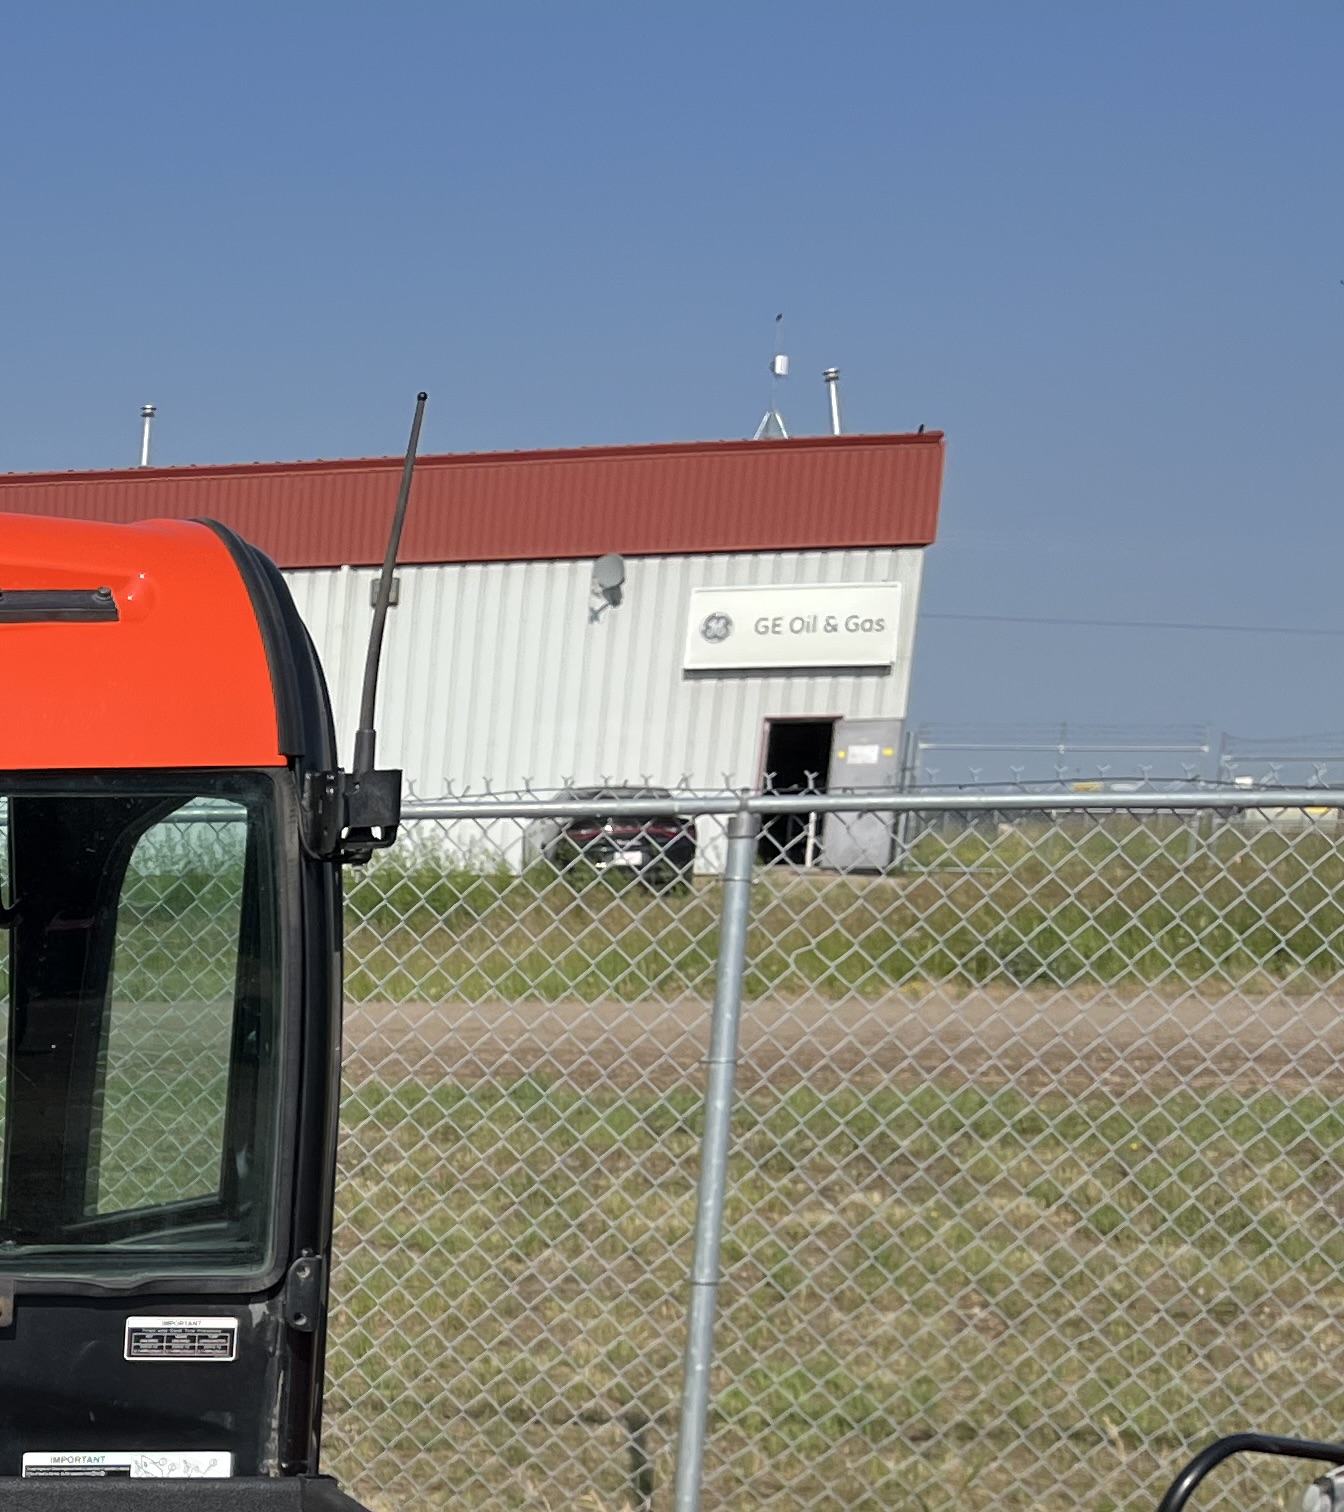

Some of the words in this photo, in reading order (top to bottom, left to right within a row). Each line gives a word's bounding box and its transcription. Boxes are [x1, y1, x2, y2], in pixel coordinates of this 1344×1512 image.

[754, 616, 783, 635] GE
[789, 615, 817, 634] Oil
[823, 616, 838, 633] &
[844, 615, 885, 633] Gas
[50, 1456, 106, 1464] IMPORTANT
